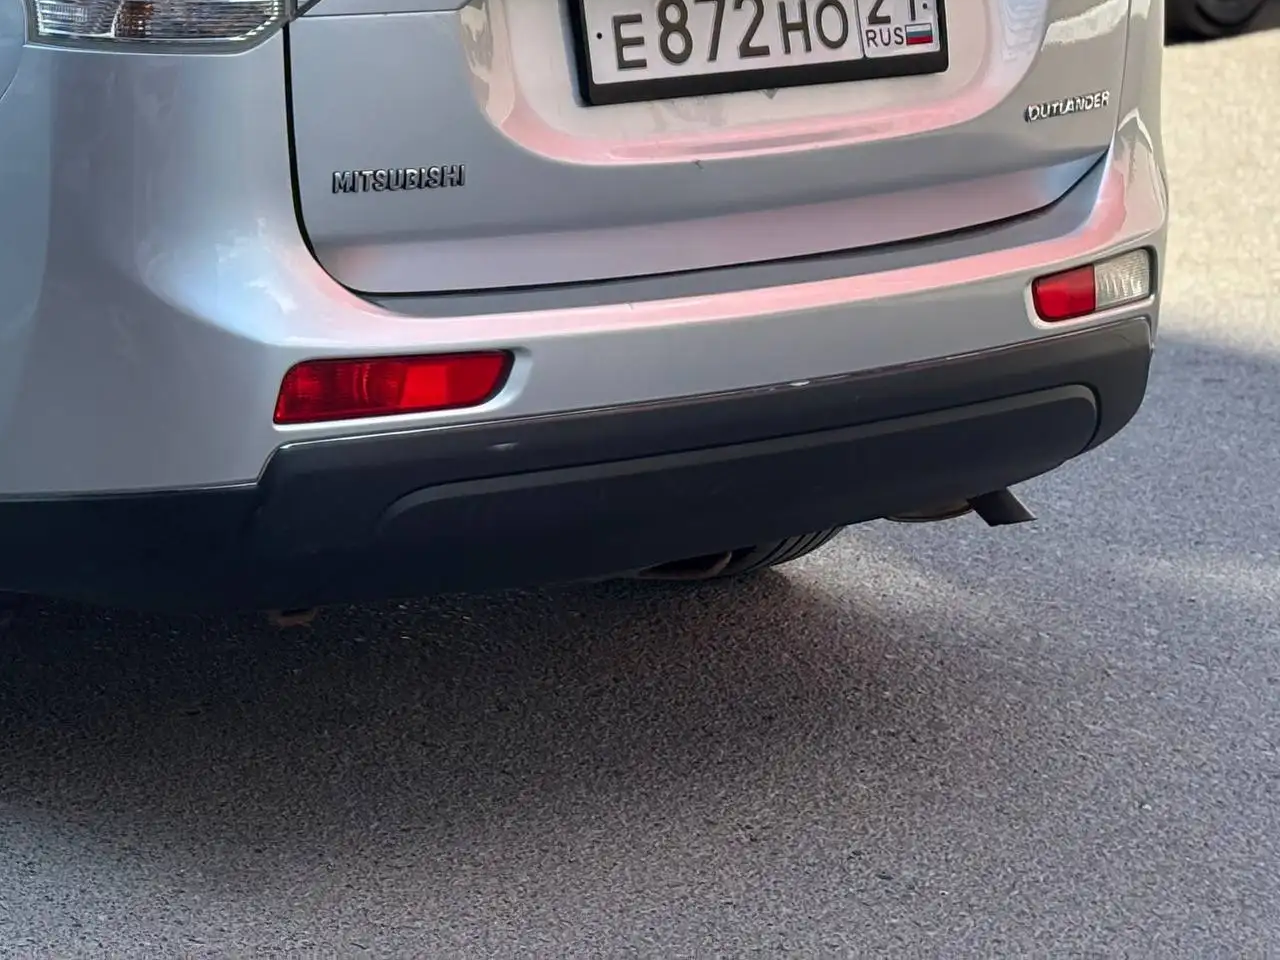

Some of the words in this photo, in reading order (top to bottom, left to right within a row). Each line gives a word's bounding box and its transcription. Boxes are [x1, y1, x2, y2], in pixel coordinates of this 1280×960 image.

[866, 27, 904, 48] RUS
[1024, 90, 1110, 122] OUTLANDER
[332, 164, 465, 194] MITSUBISHI
